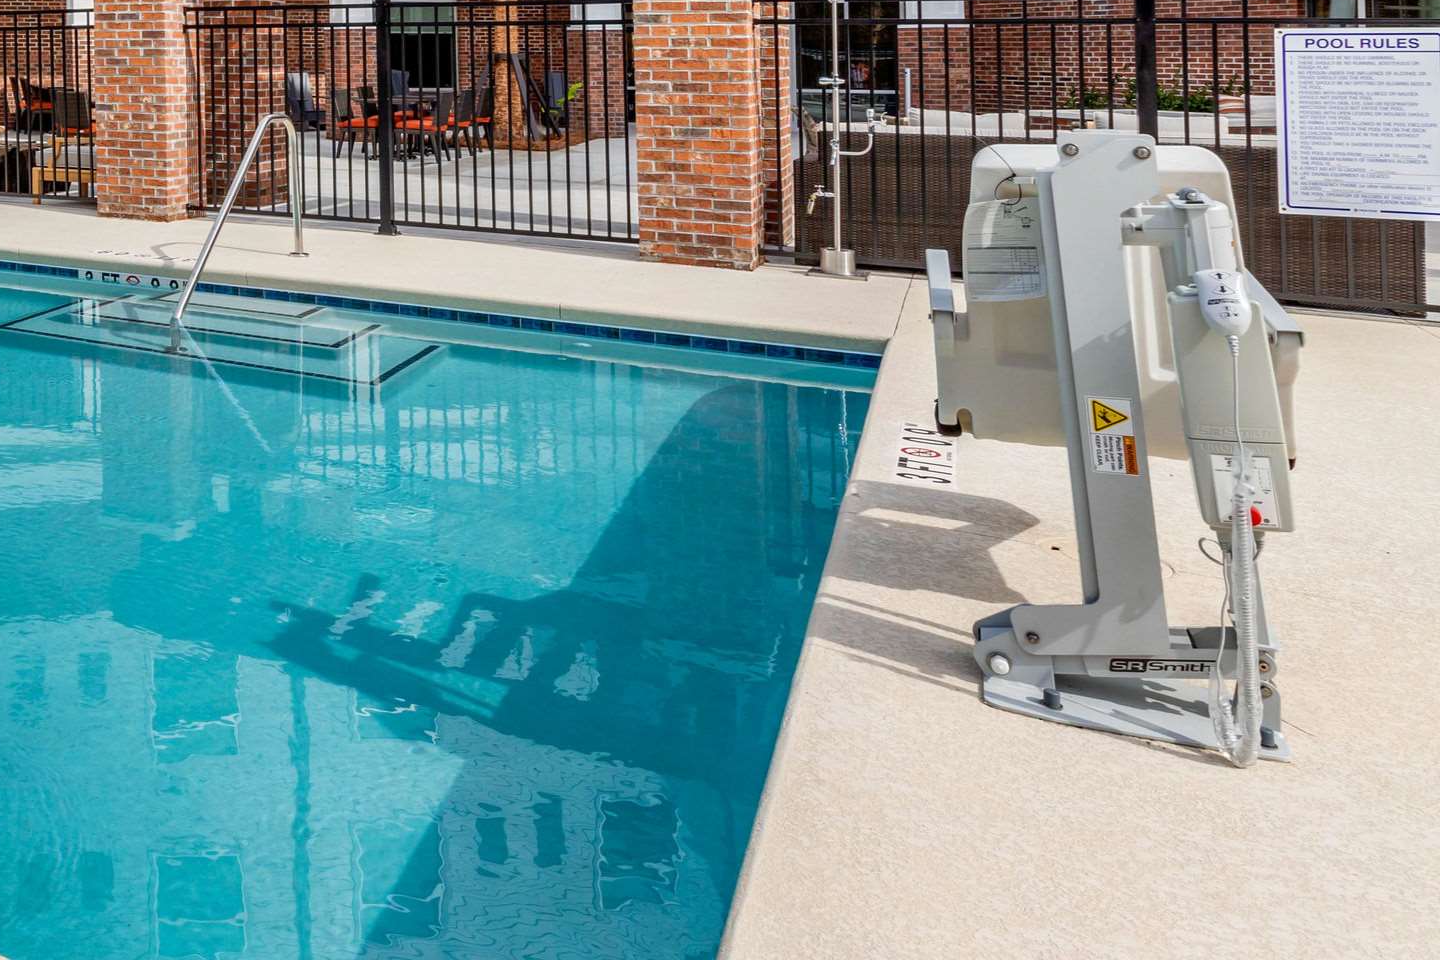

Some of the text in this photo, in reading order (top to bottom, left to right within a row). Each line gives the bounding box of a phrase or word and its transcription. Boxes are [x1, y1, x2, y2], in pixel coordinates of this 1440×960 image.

[1305, 38, 1420, 49] POOL RULES
[897, 456, 952, 475] FT
[1110, 660, 1211, 672] SR Smith
